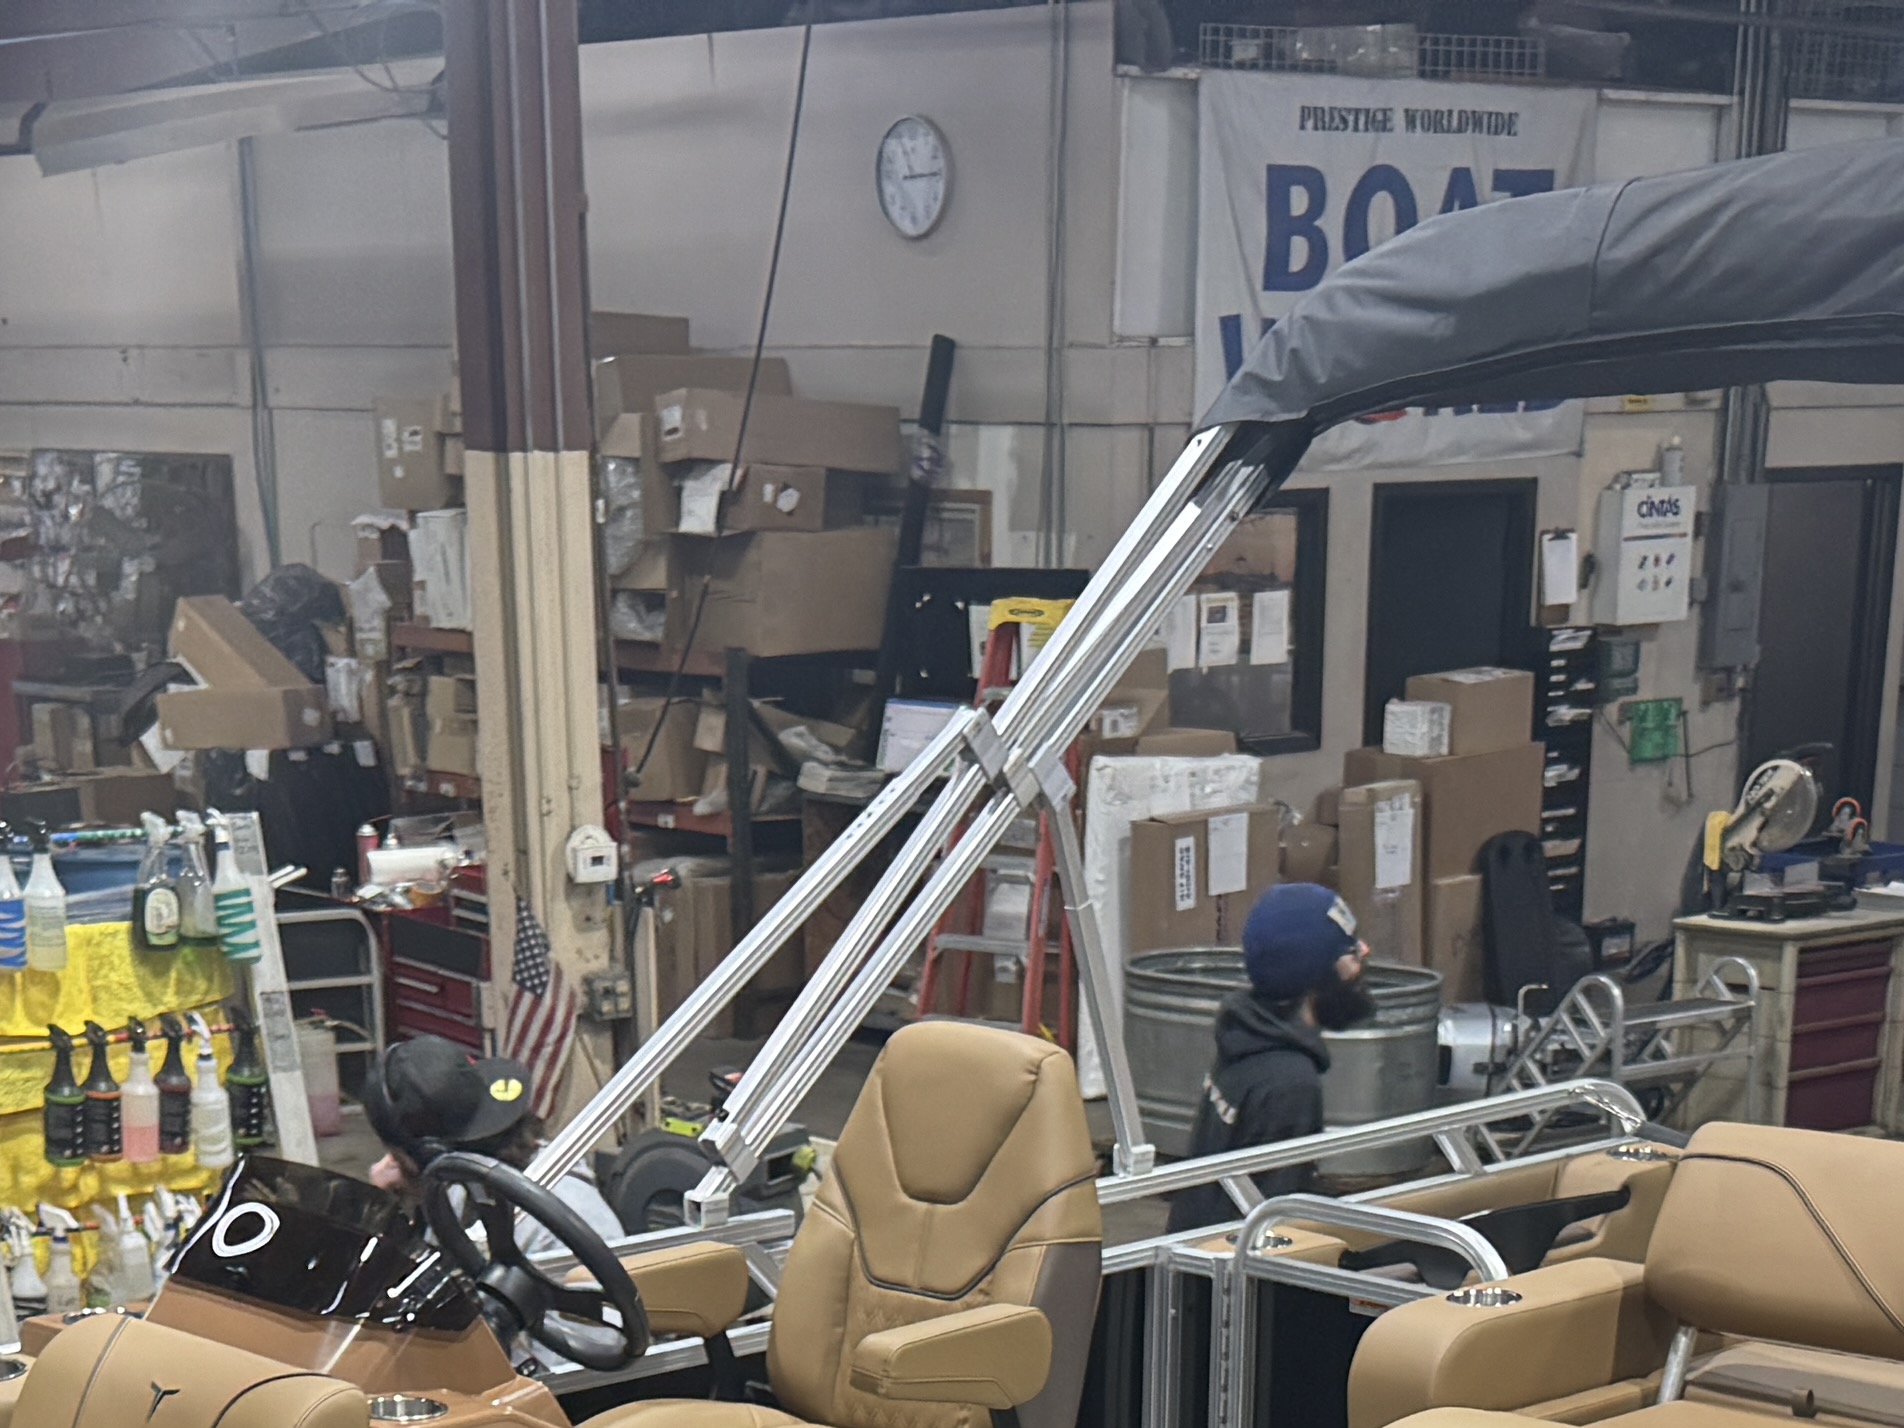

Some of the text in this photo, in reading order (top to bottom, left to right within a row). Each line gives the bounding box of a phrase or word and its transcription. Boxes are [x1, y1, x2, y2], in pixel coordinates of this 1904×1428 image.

[1299, 105, 1520, 137] PRESTIGE WORLDWIDE
[1262, 163, 1556, 292] BO
